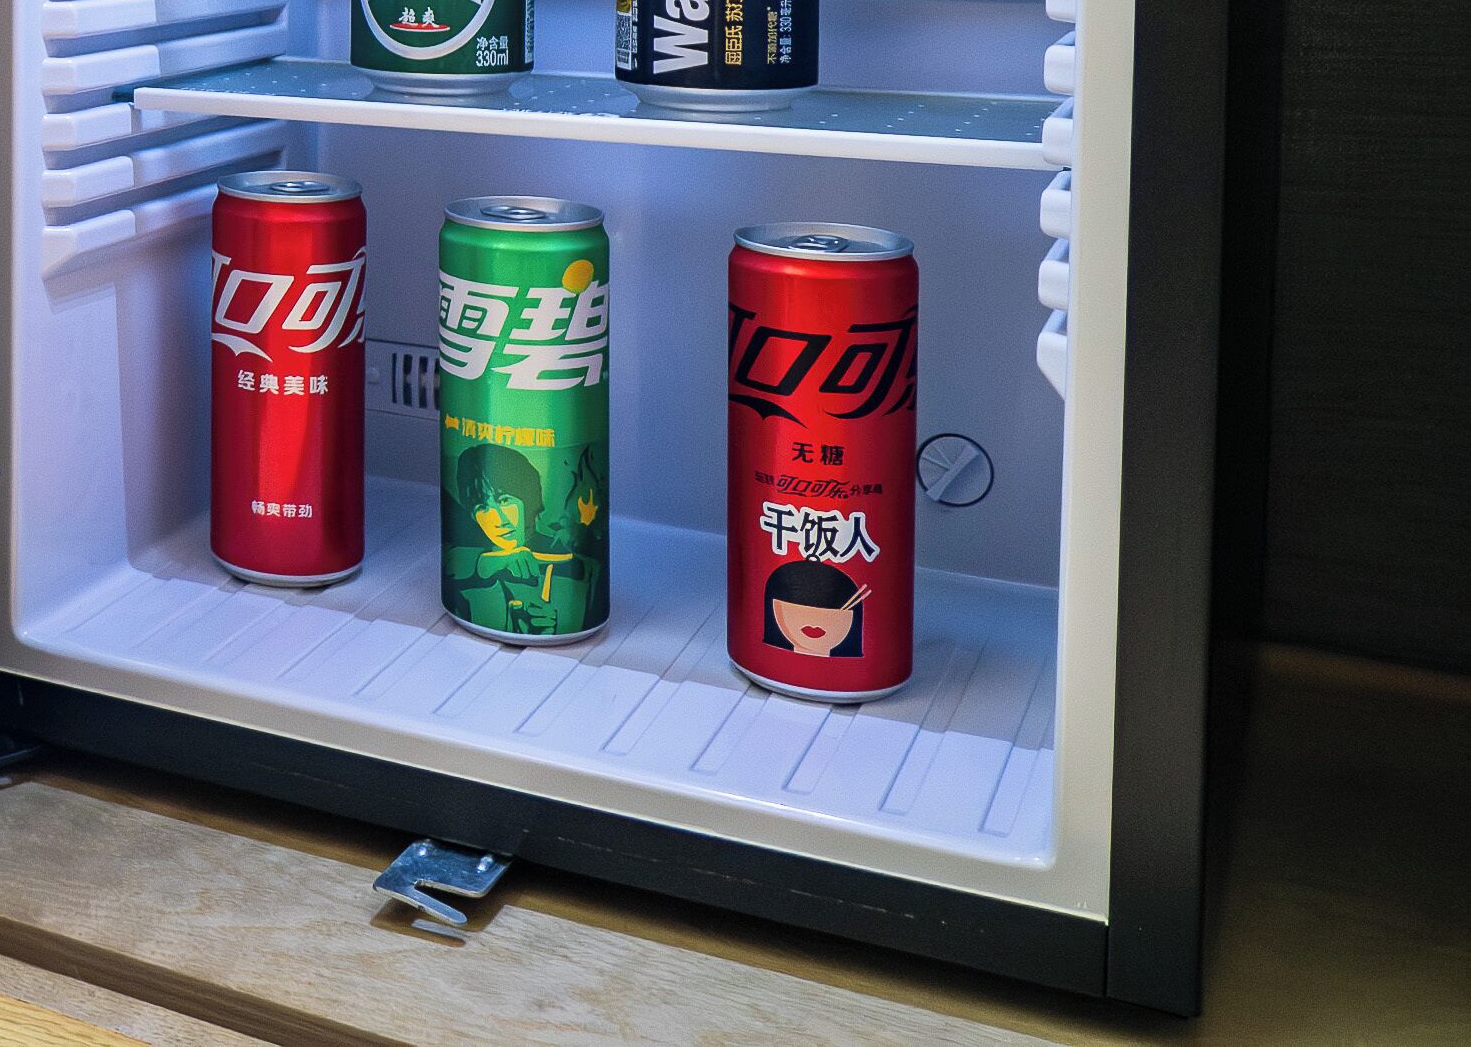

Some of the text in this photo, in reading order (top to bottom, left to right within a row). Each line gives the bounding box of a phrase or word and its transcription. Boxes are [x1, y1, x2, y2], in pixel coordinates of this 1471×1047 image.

[398, 6, 440, 28] 超爽
[476, 35, 509, 50] 净含量
[475, 50, 509, 67] 330ml
[439, 269, 609, 391] 雪碧
[237, 369, 329, 396] 经典美味
[791, 441, 845, 466] 无糖
[251, 500, 313, 519] 畅爽带劲
[761, 503, 879, 560] 干饭人
